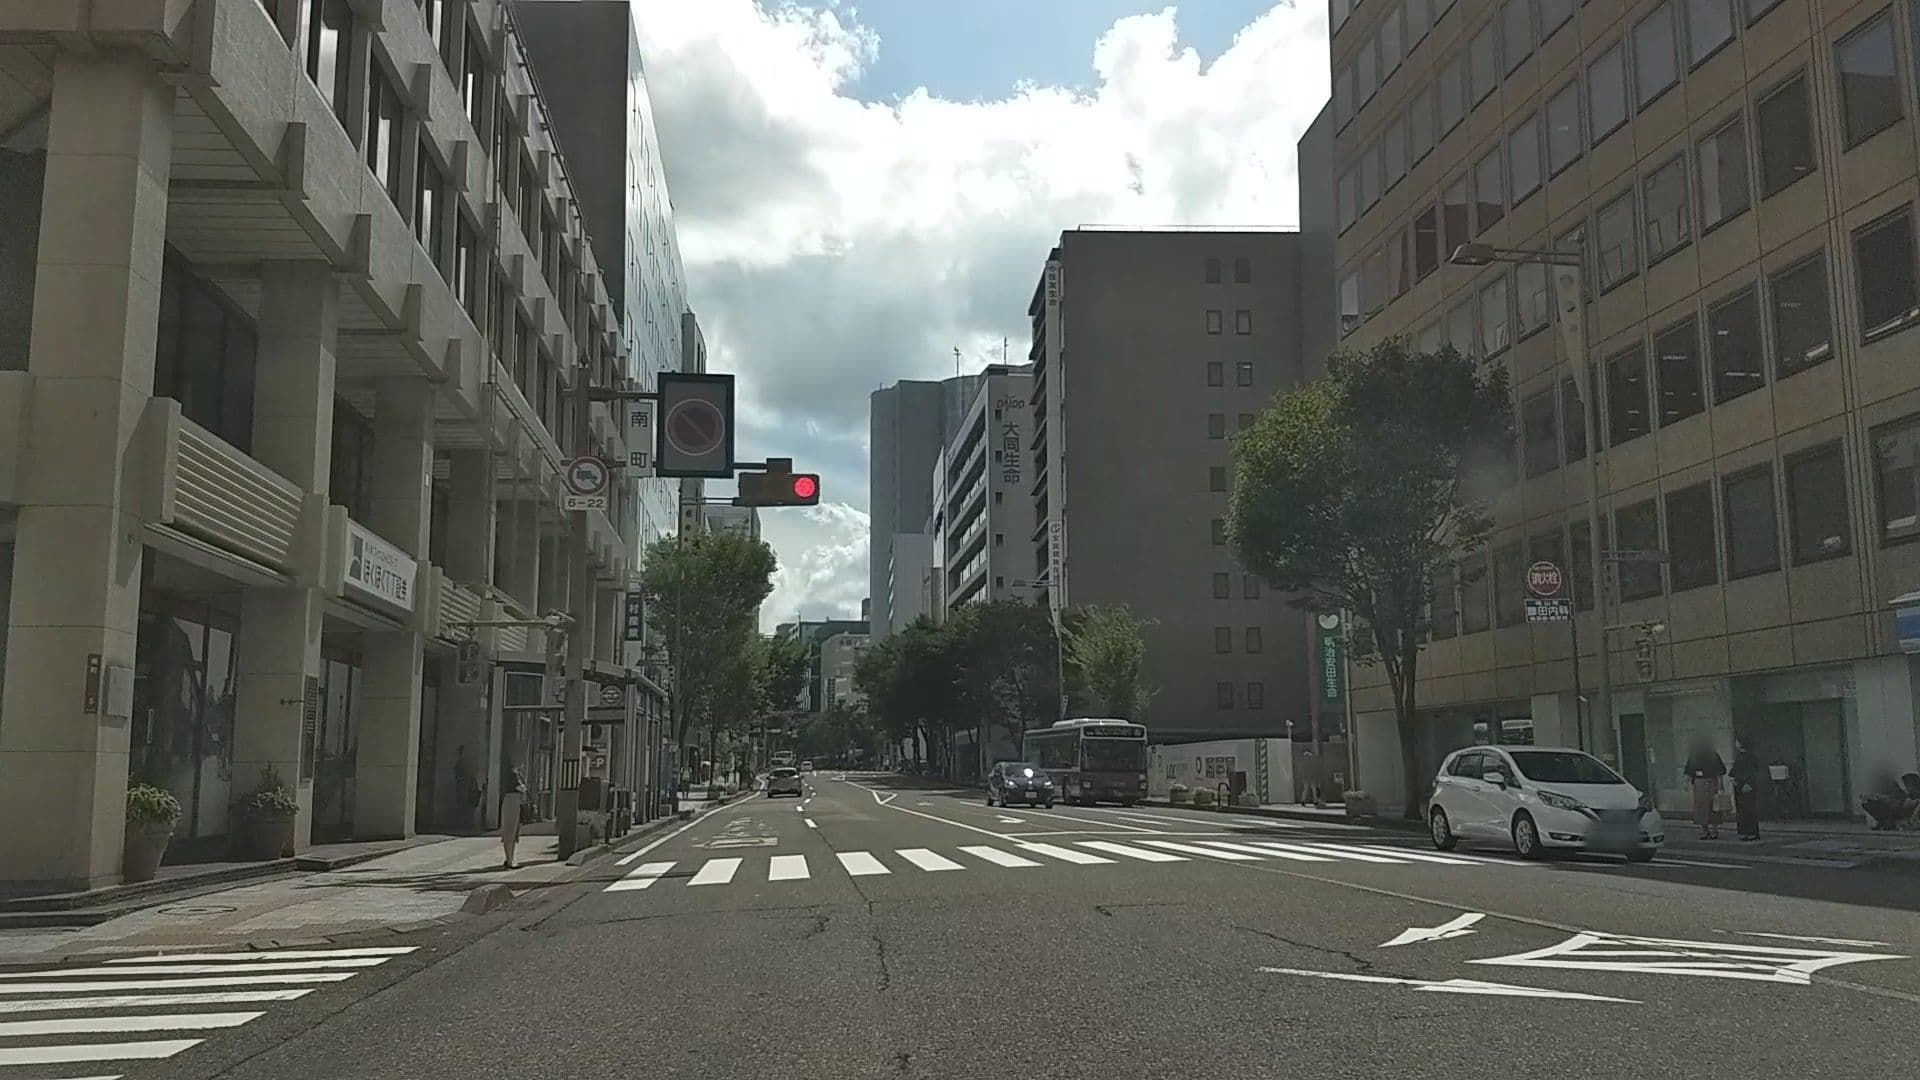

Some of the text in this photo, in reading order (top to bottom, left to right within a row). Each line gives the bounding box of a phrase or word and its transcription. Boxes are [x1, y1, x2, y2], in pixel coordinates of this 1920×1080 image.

[631, 411, 649, 468] 南町
[1002, 420, 1021, 484] 大同生命
[567, 498, 604, 508] 6-22
[1531, 571, 1559, 585] 消火栓
